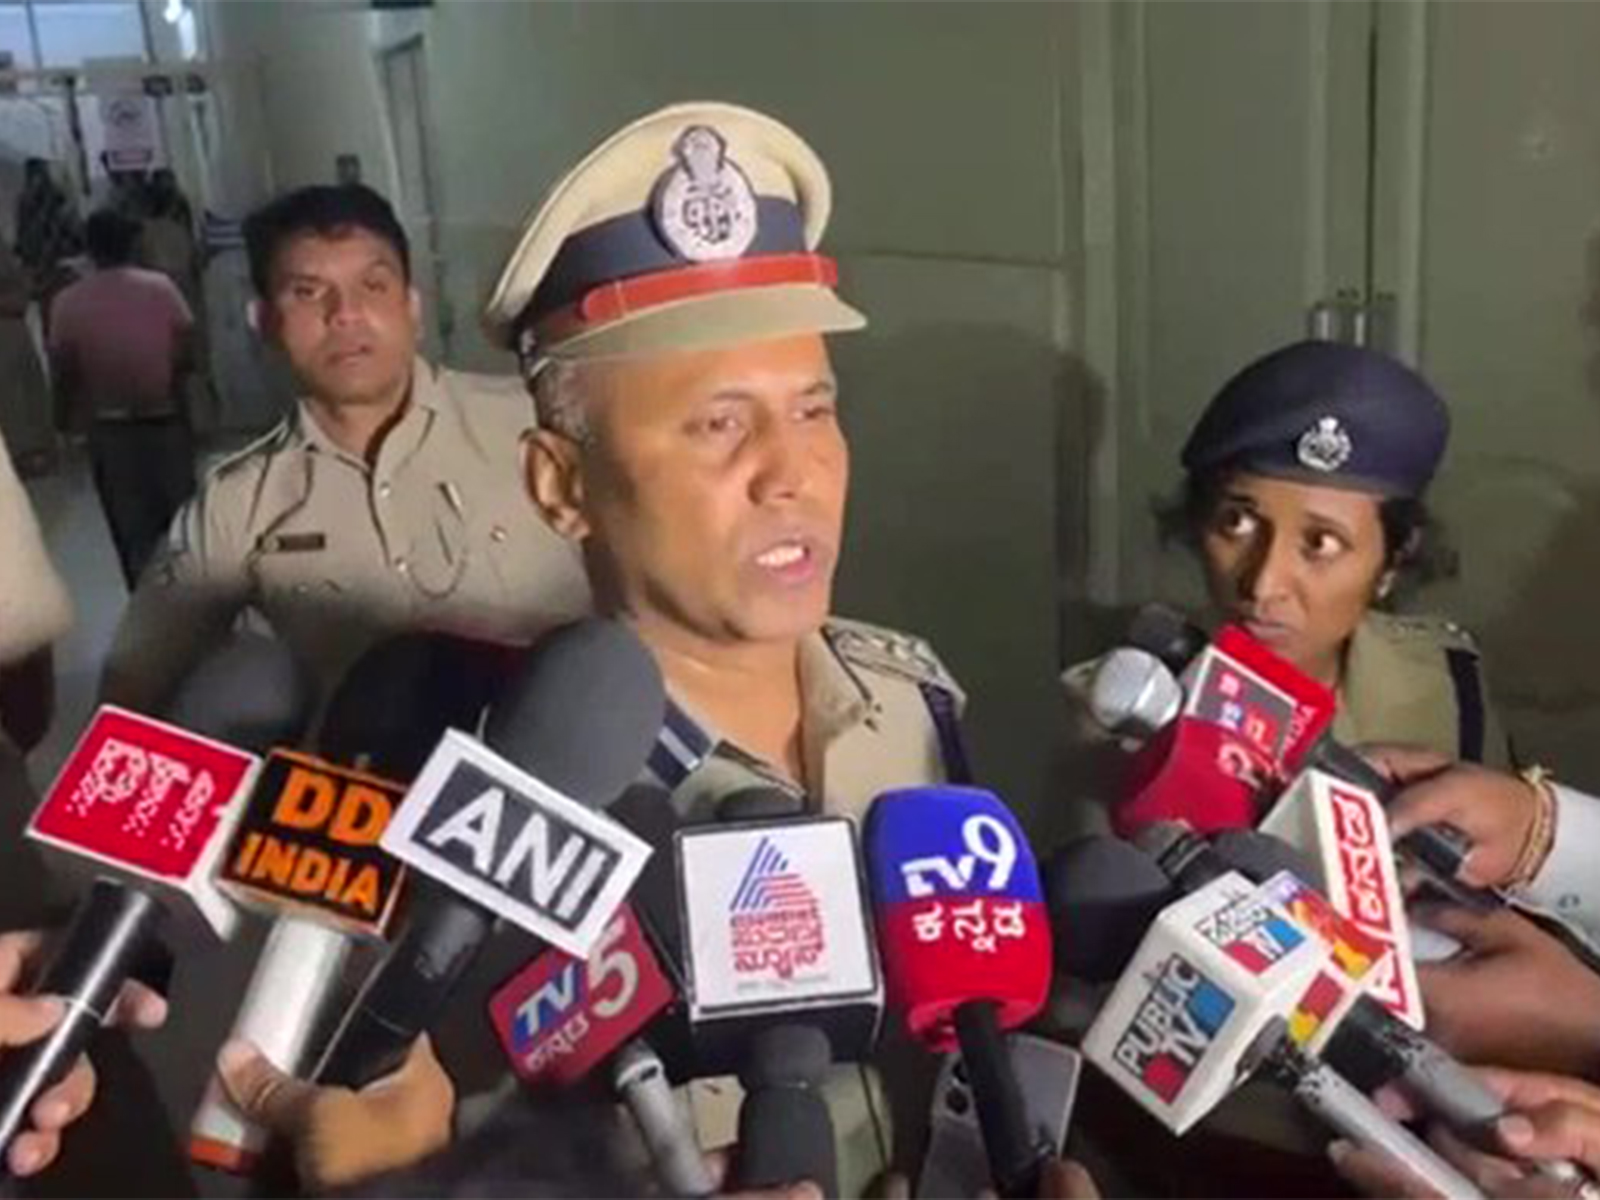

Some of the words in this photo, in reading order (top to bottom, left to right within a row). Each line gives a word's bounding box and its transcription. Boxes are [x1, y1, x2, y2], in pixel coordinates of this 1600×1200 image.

[273, 766, 392, 845] DD
[236, 832, 380, 914] INDIA
[425, 786, 607, 919] ANI
[901, 815, 1016, 897] TV9
[912, 902, 1026, 953] ಕನ್ನಡ
[1116, 957, 1200, 1075] PUBLIC
[1158, 1009, 1209, 1067] TV
